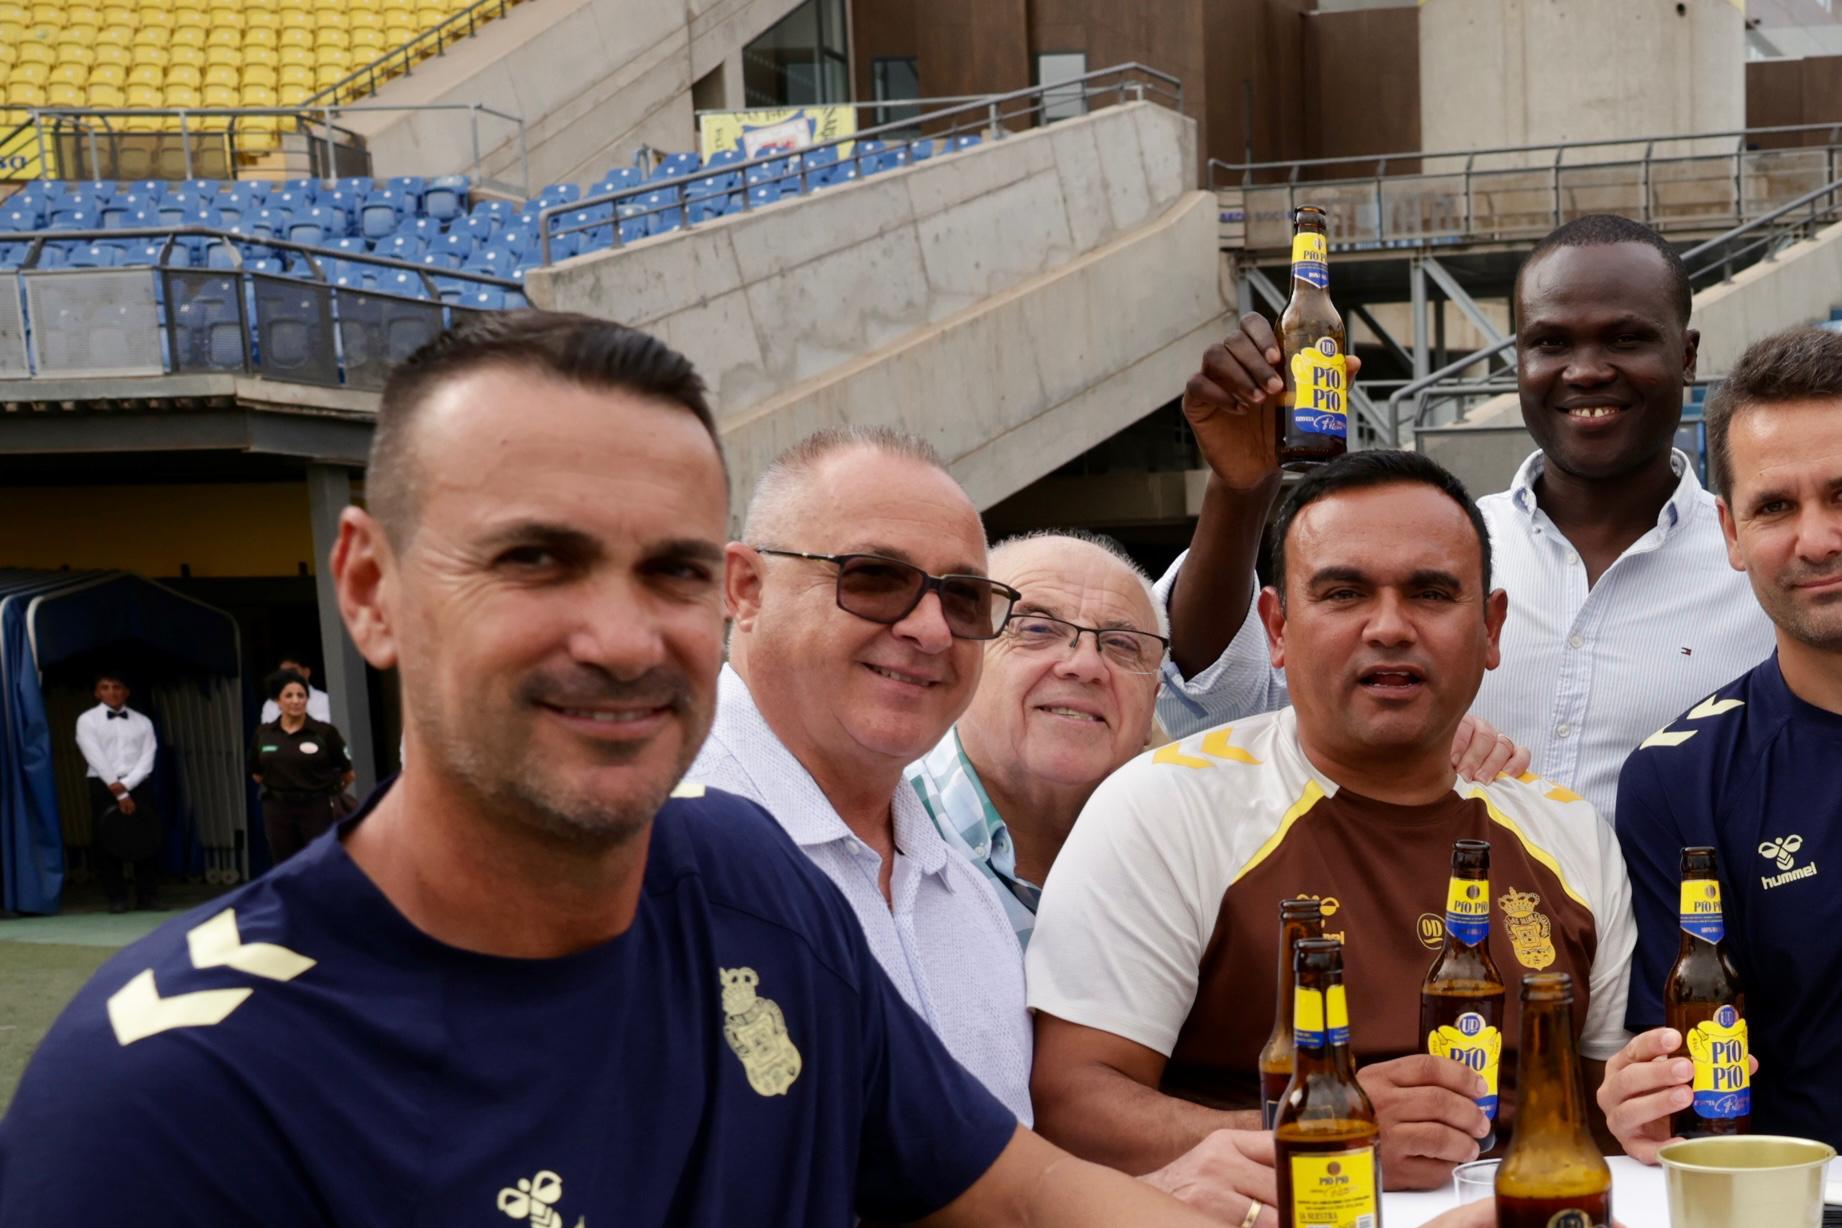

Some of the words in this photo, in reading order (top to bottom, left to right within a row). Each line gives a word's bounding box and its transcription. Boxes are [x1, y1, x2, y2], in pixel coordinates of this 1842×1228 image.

[1312, 366, 1341, 390] PÍO
[1312, 388, 1341, 412] PÍO
[1761, 861, 1818, 890] hummel
[1454, 899, 1472, 913] PÍO
[1693, 900, 1712, 913] PÍO
[1711, 1039, 1742, 1064] PÍO
[1712, 1063, 1744, 1090] PÍO
